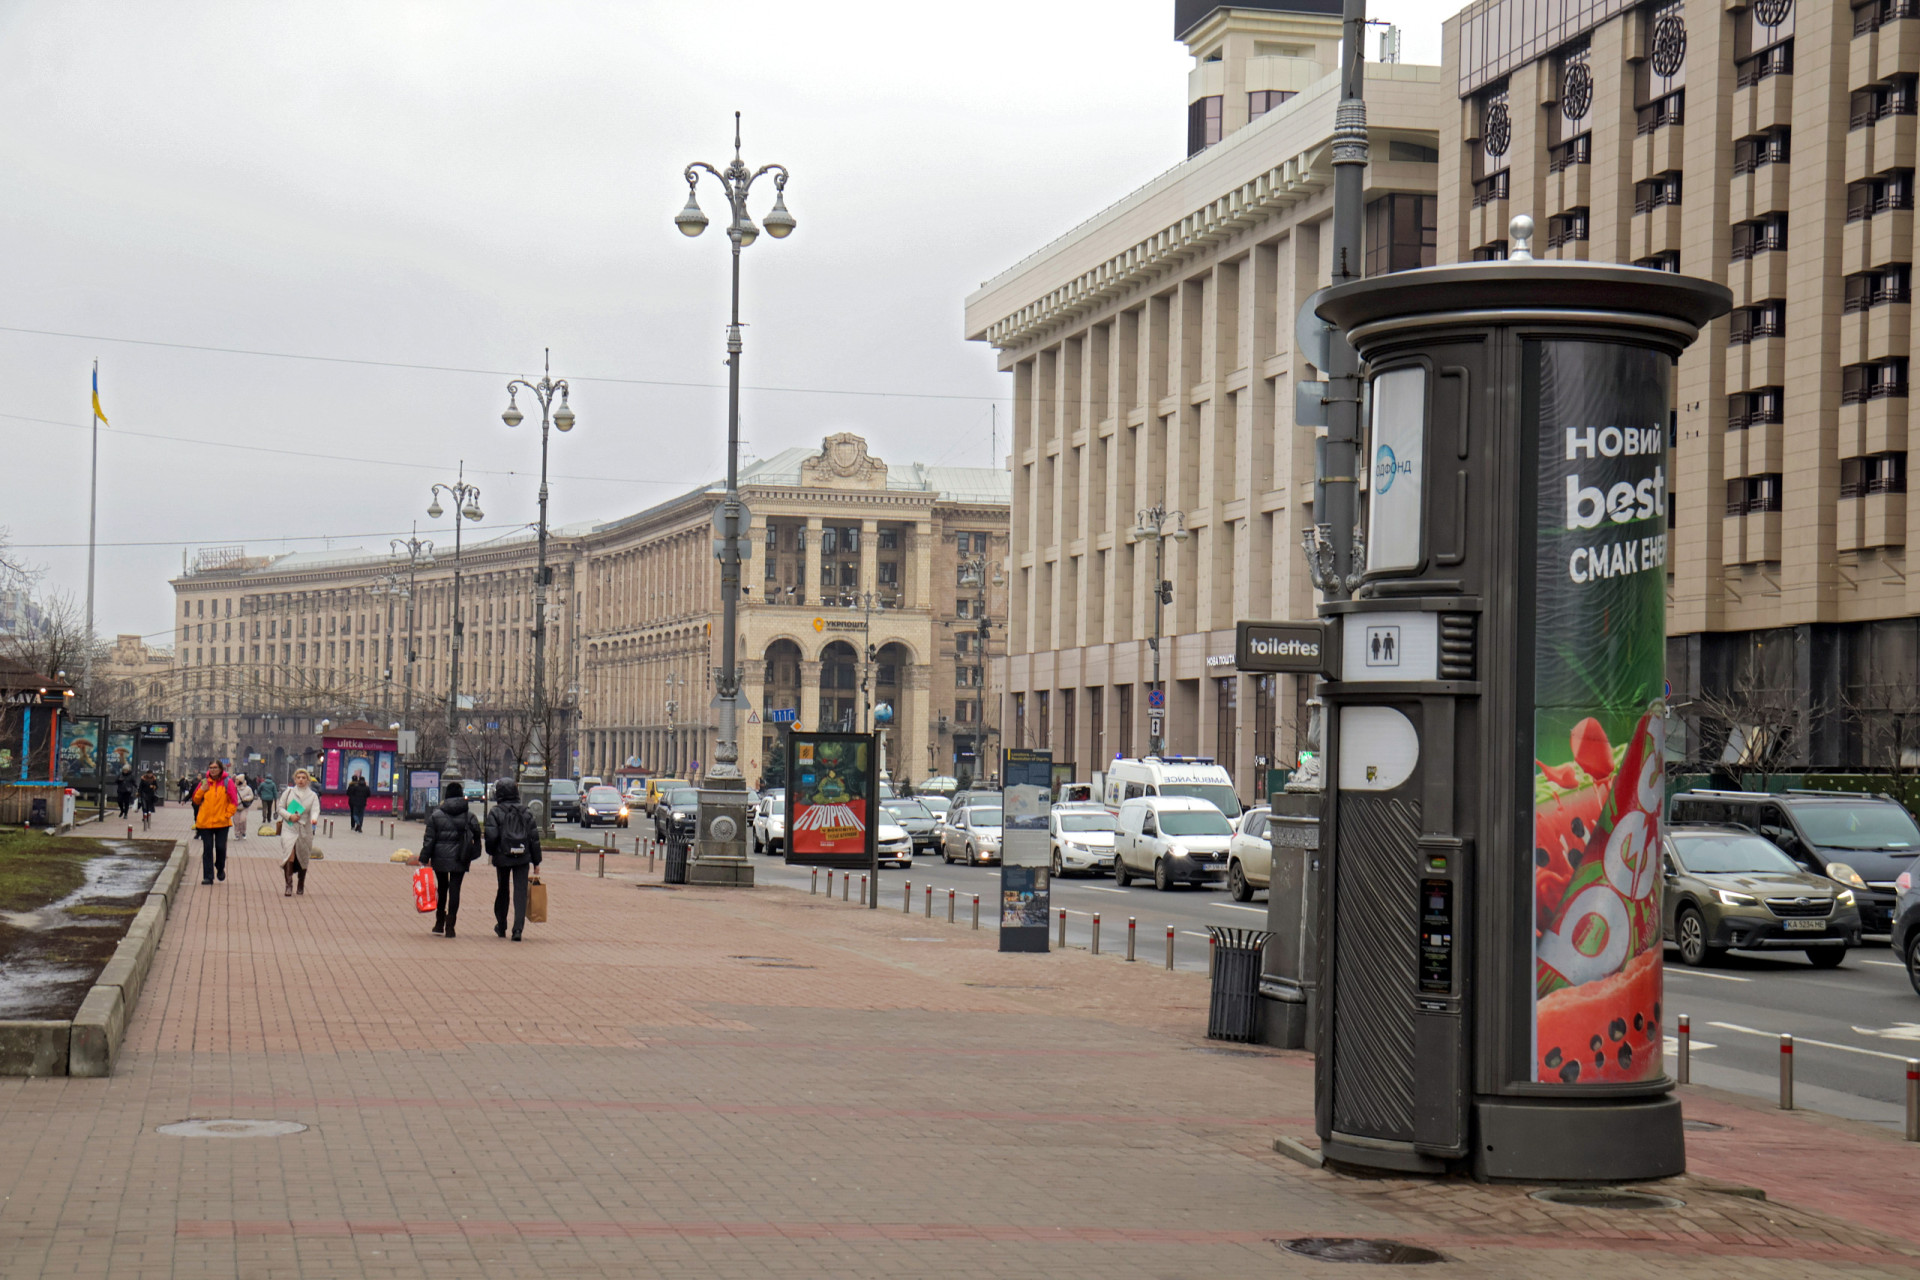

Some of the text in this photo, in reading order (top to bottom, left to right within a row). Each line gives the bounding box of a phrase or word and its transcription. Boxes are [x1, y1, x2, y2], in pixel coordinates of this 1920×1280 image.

[1566, 423, 1661, 460] НОВИЙ
[1566, 465, 1664, 530] best
[1569, 534, 1666, 584] СМАК ЕНЕ
[1250, 637, 1319, 657] toilettes
[1206, 655, 1219, 667] НОВА
[337, 739, 364, 748] ulitka
[792, 804, 866, 832] СТВОРЮЙ
[1787, 920, 1798, 928] KA
